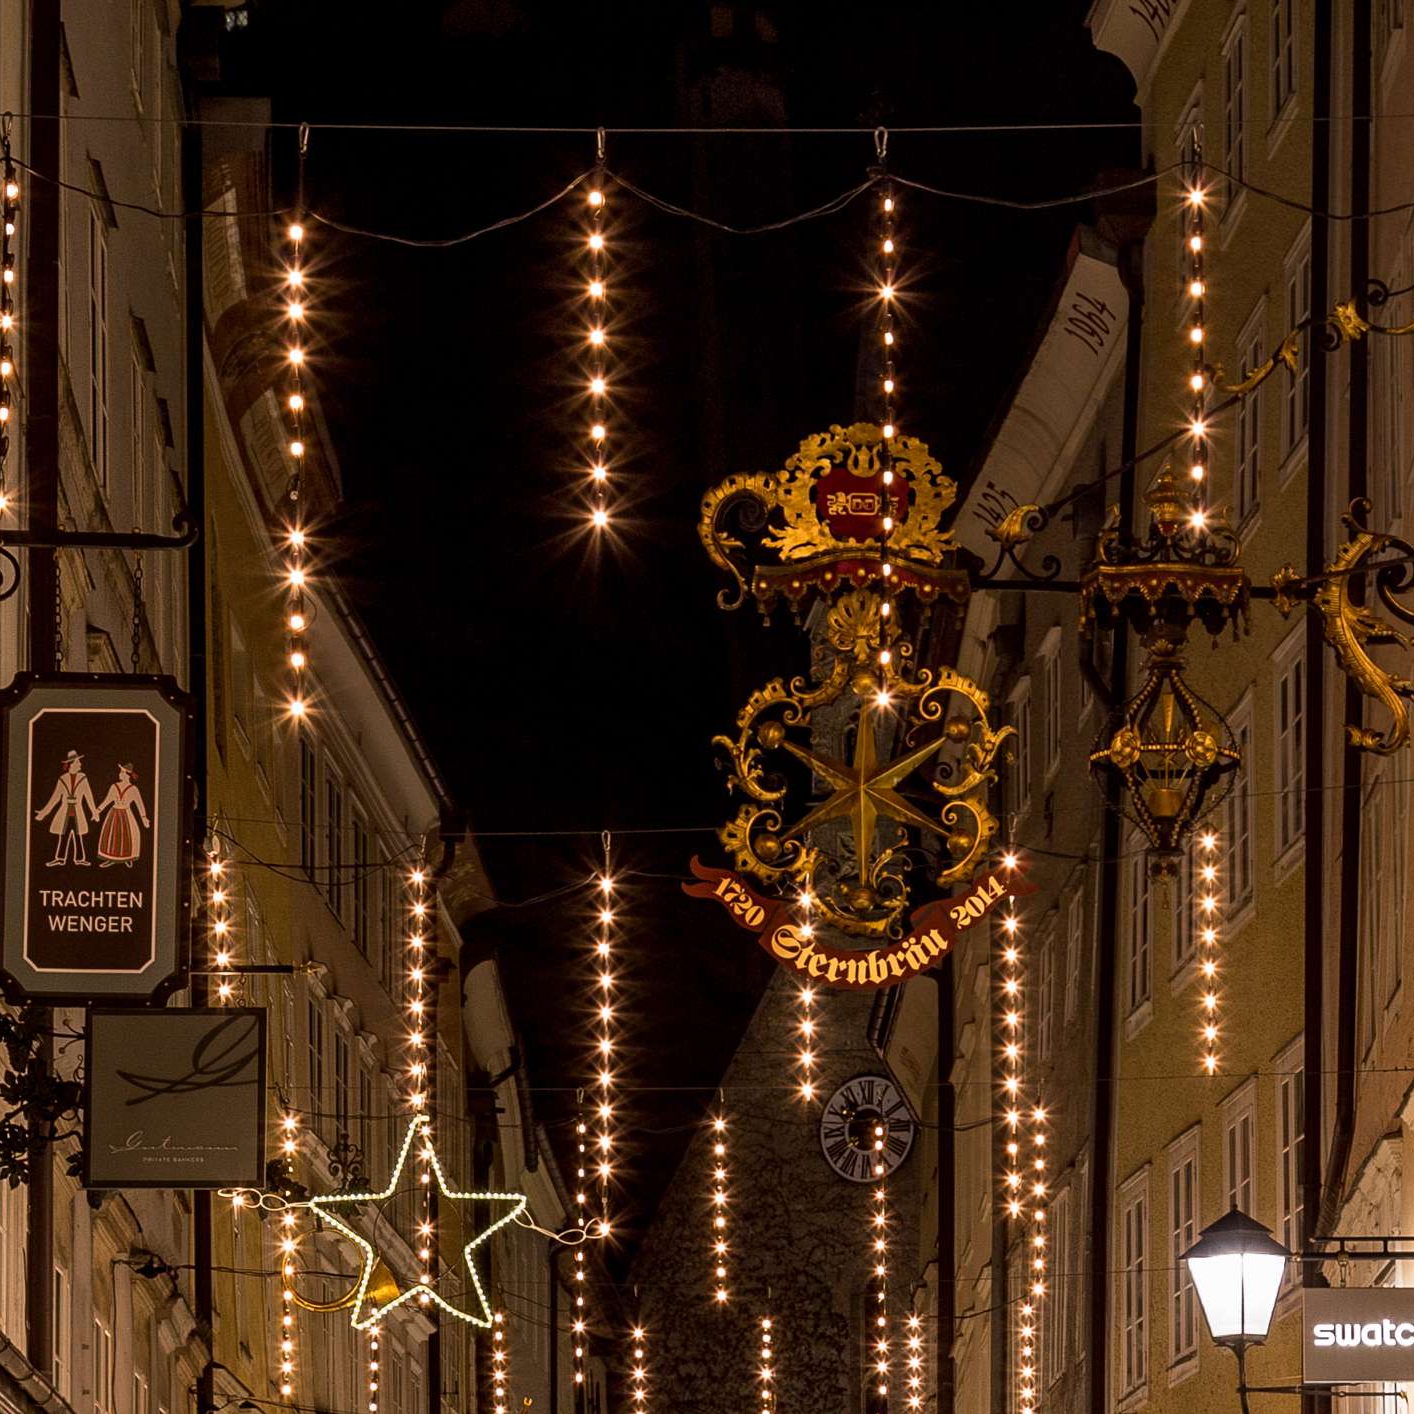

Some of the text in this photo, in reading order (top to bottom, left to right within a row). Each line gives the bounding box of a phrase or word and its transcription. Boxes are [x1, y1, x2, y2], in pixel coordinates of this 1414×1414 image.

[39, 890, 143, 909] TRACHTEN
[48, 915, 133, 933] WENGER
[713, 875, 1007, 985] 1720 Sternbräu 2014
